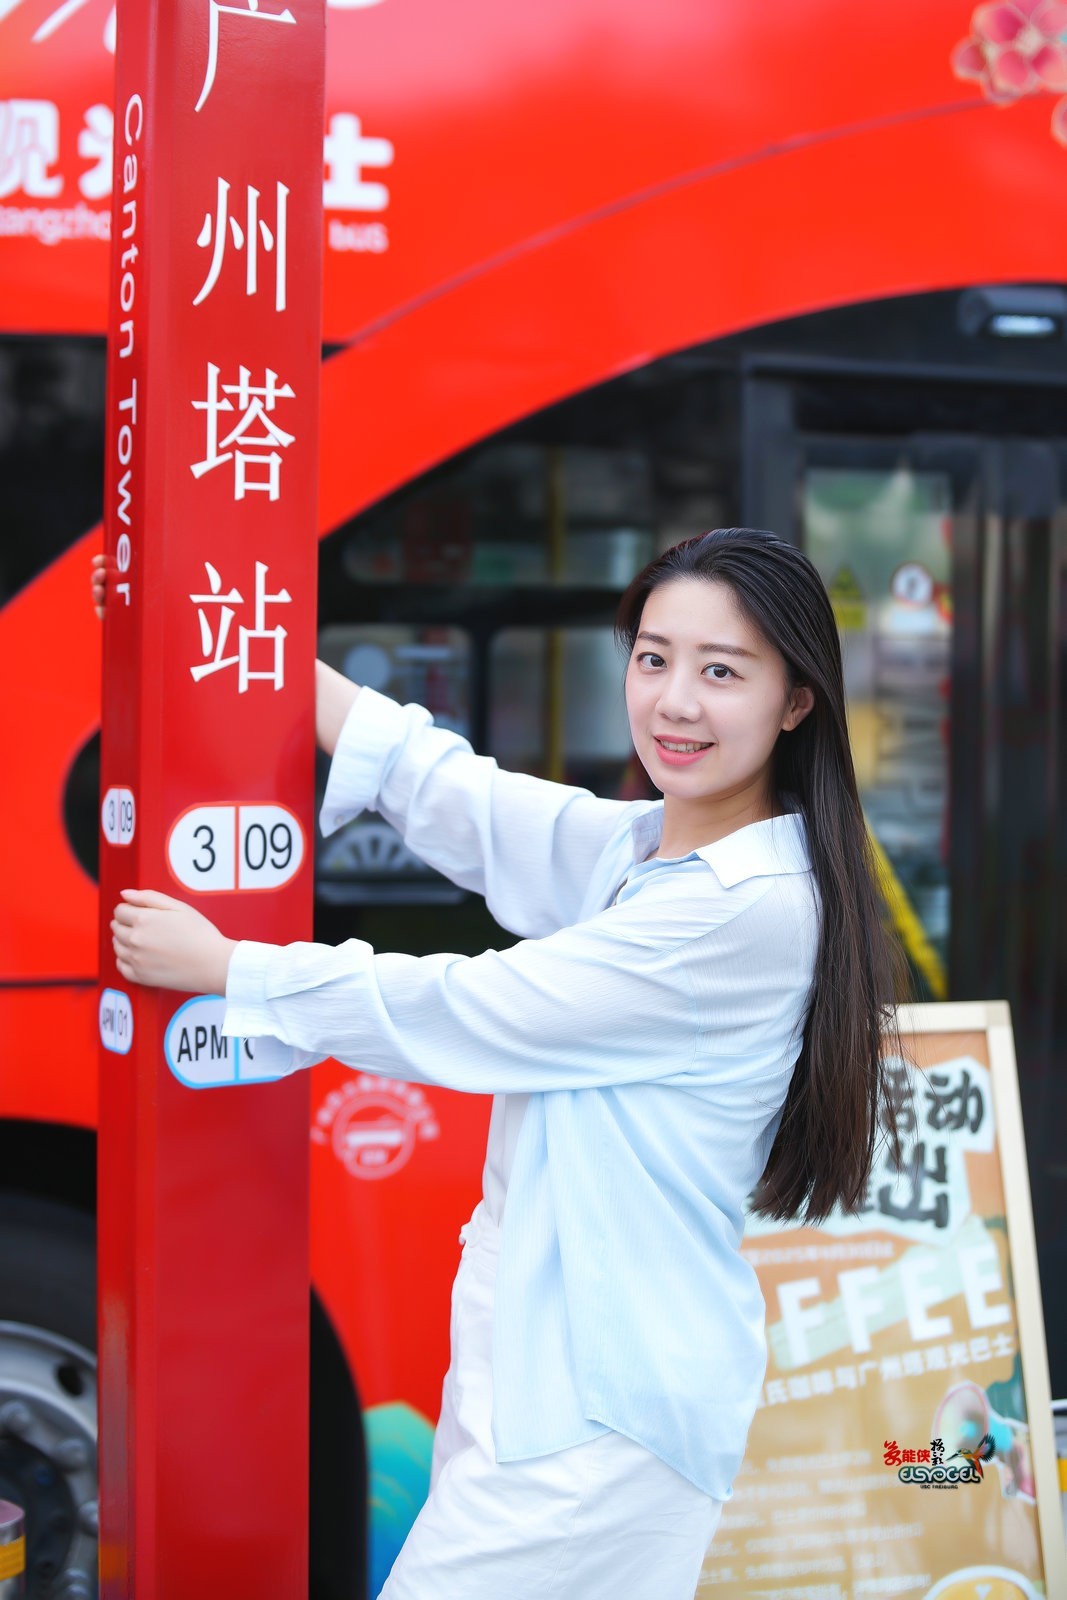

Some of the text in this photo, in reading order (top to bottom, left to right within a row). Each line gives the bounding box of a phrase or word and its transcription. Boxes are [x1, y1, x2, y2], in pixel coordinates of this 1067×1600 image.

[116, 94, 143, 606] Canton Tower
[191, 0, 297, 694] 广州塔站
[120, 800, 133, 832] 09
[192, 823, 293, 872] 3 09
[177, 1024, 228, 1063] APM
[776, 1243, 1011, 1366] FFEE
